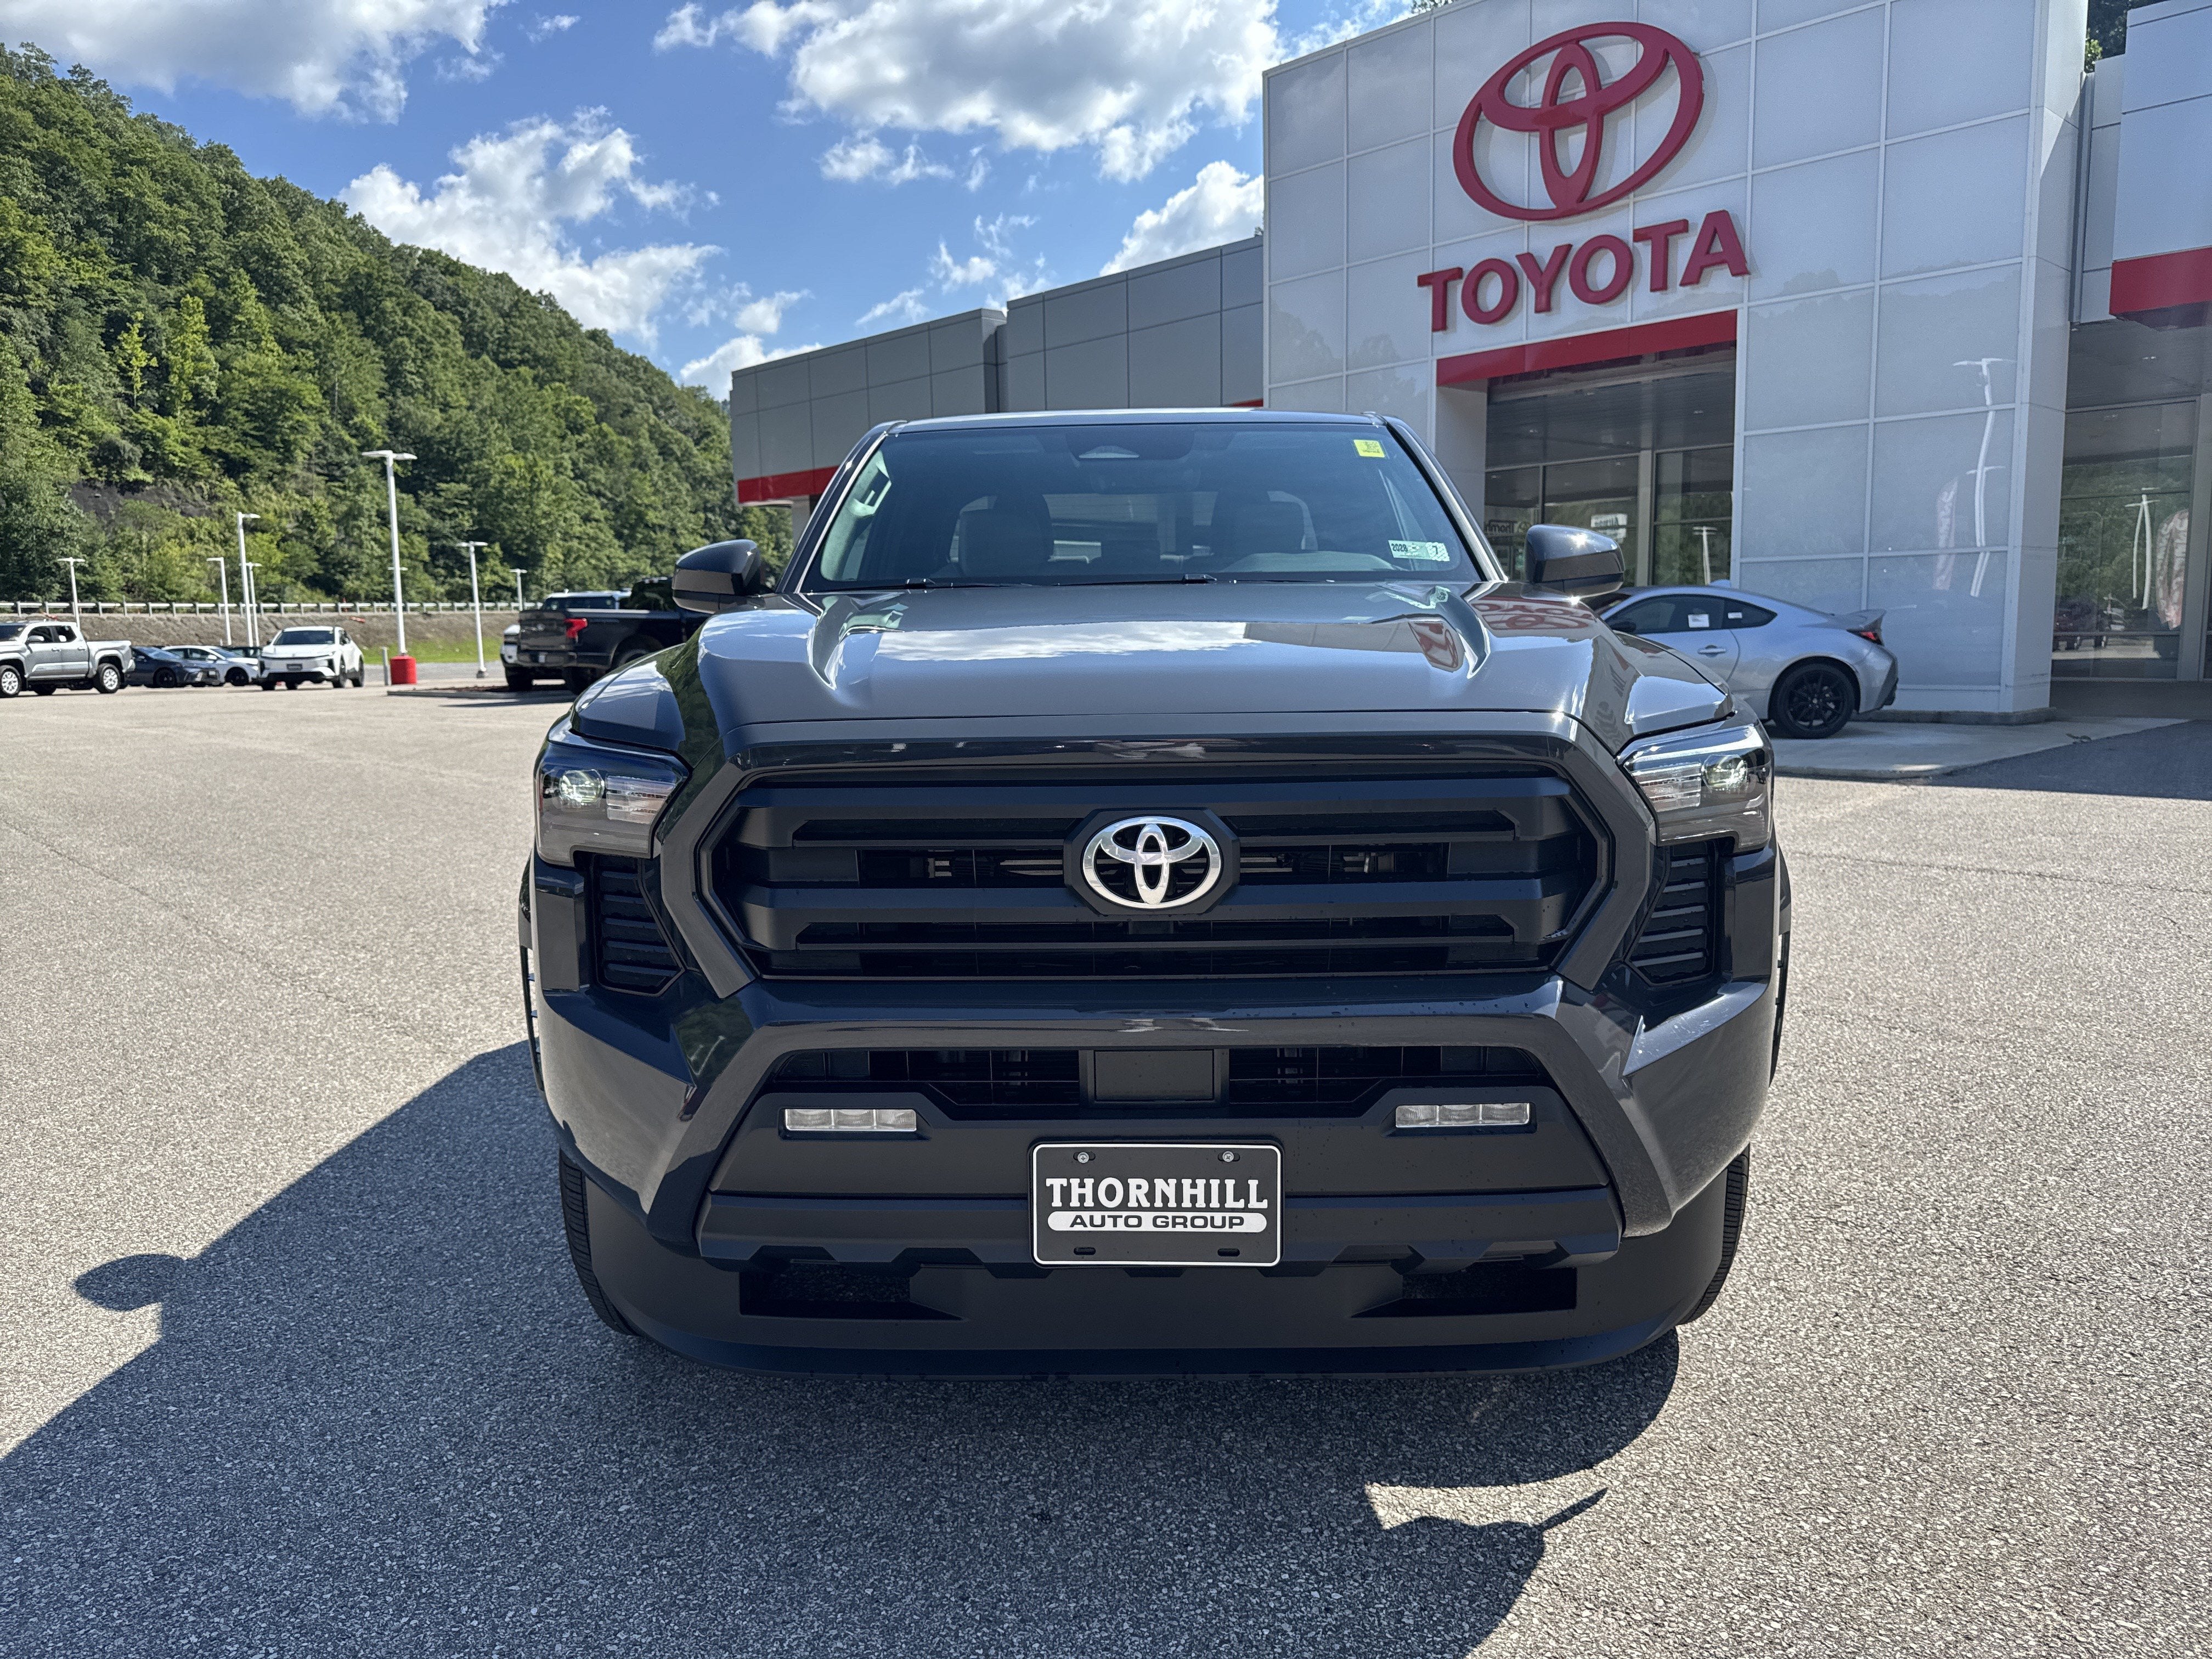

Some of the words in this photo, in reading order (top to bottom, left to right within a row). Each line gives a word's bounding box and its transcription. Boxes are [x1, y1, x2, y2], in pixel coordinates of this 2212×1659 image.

[1417, 210, 1751, 332] TOYOTA
[1046, 1177, 1268, 1209] THORNHILL
[1069, 1214, 1143, 1228] AUTO
[1152, 1215, 1245, 1229] GROUP
